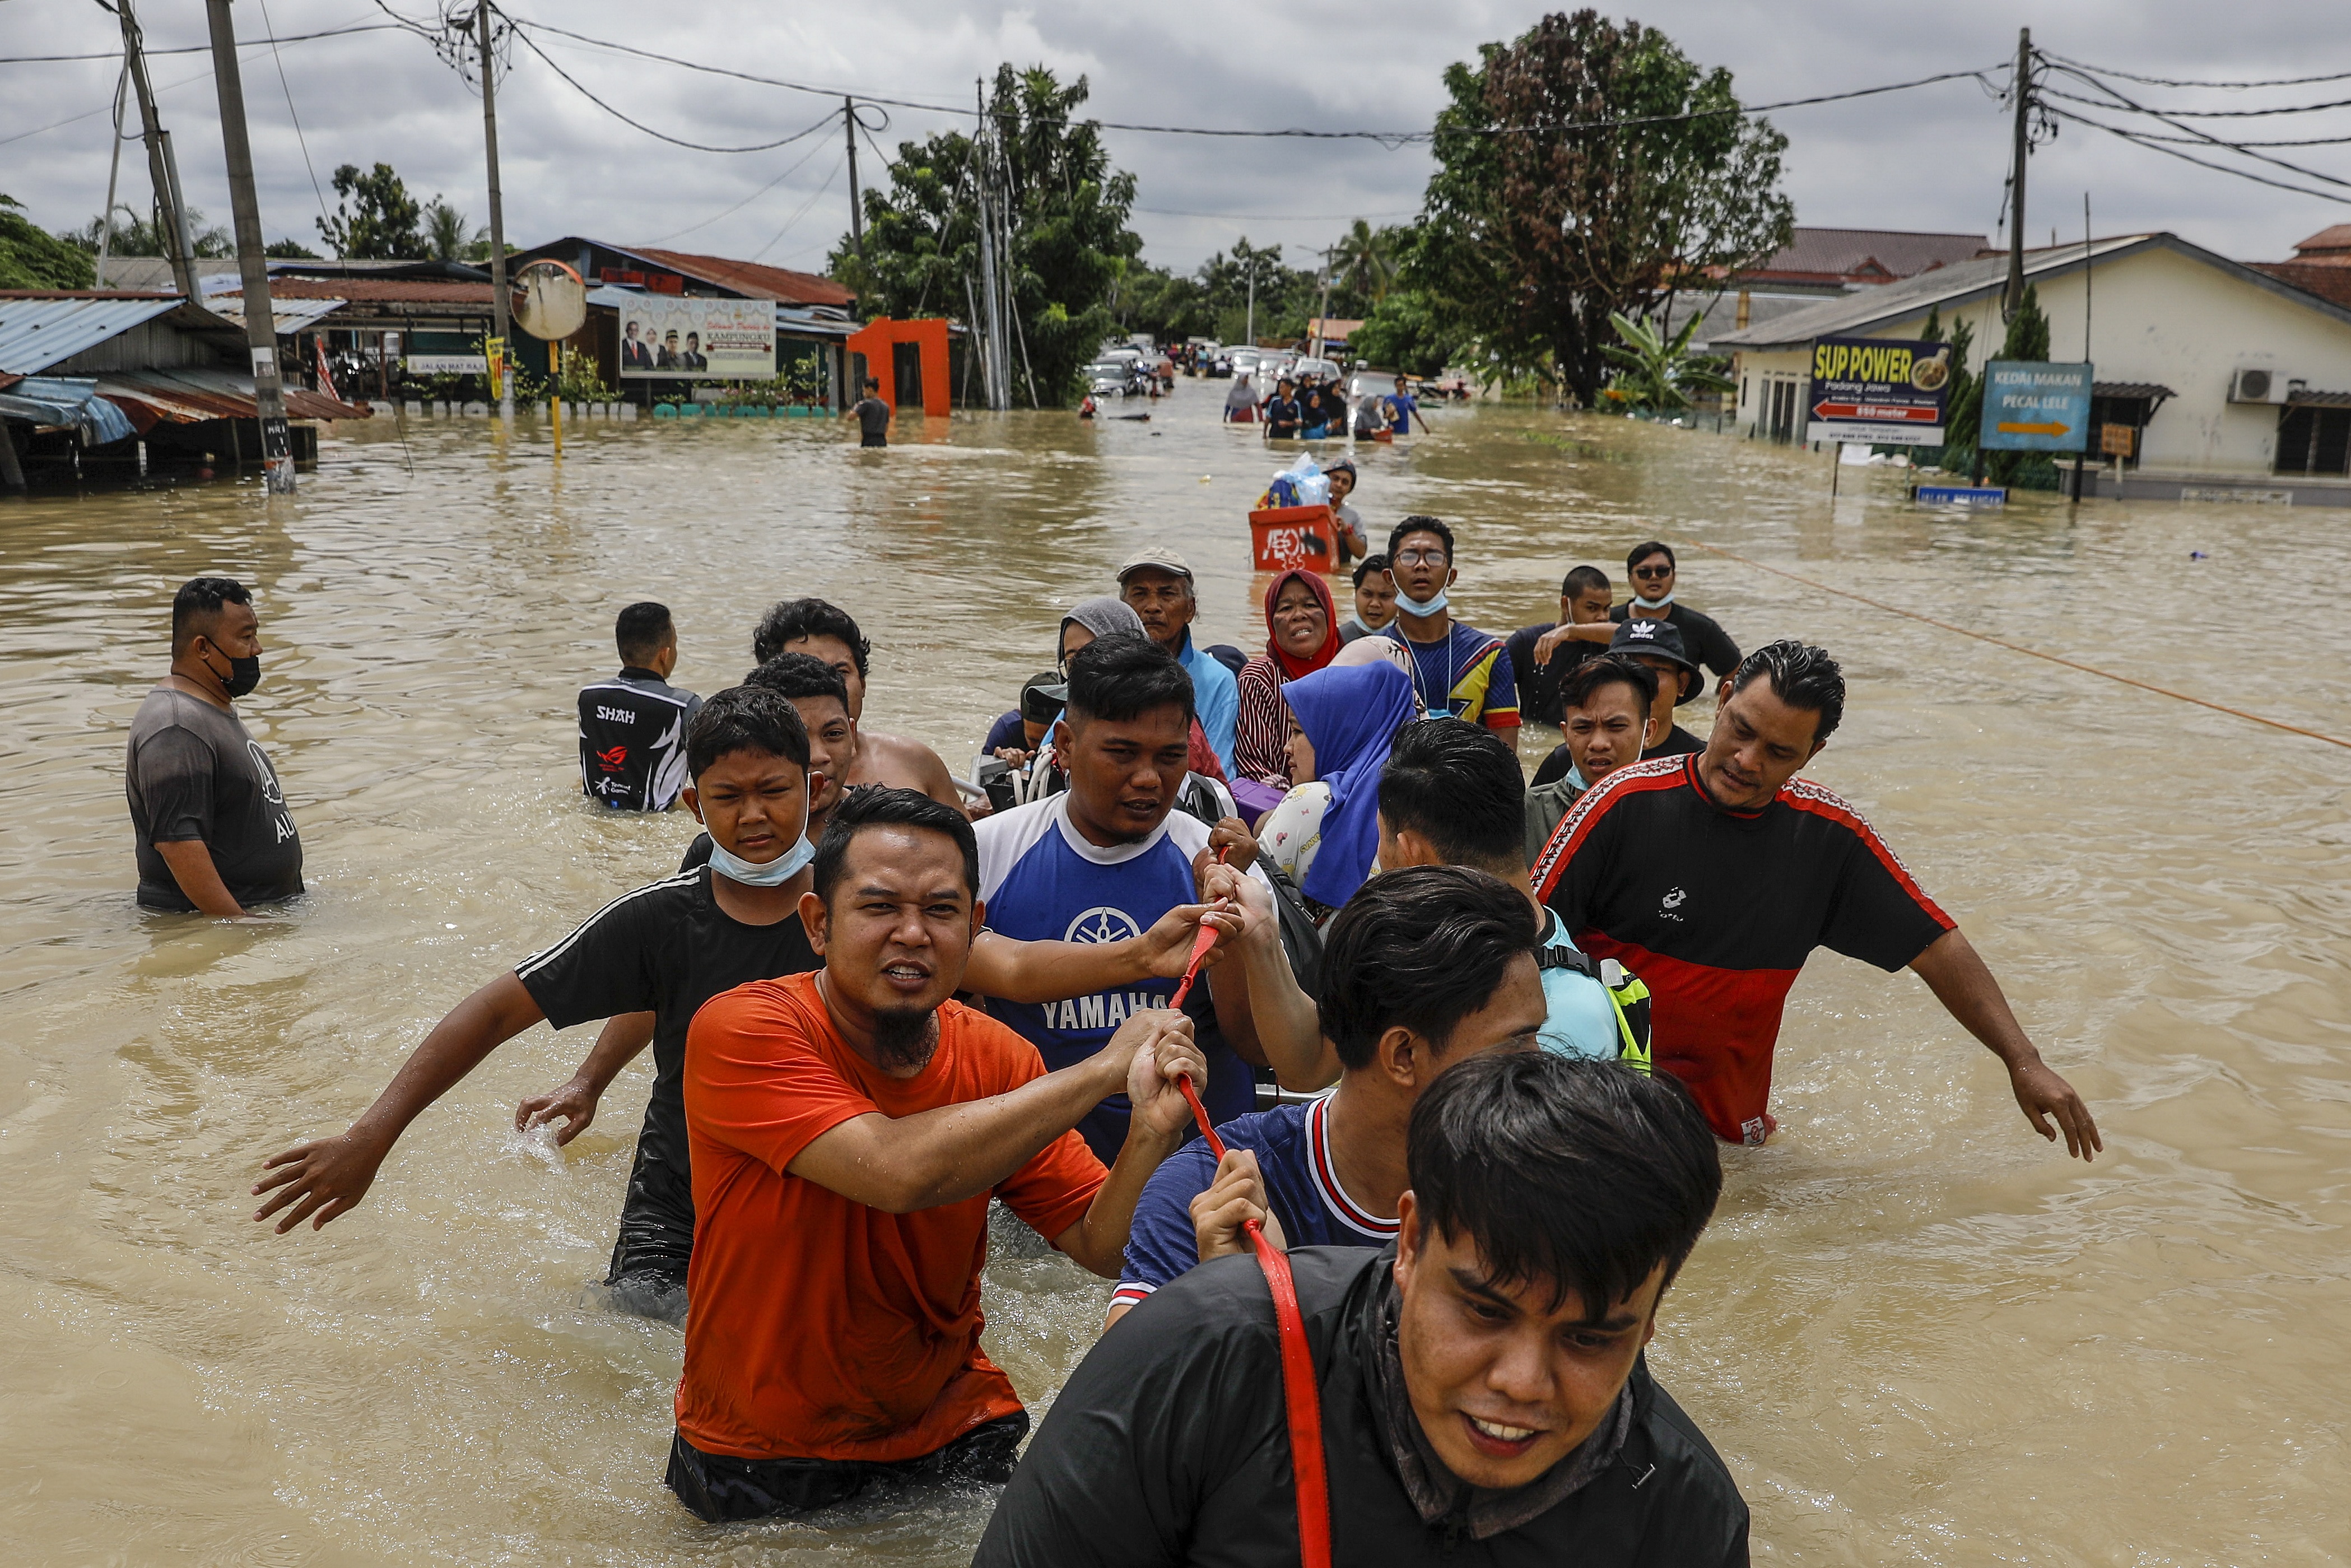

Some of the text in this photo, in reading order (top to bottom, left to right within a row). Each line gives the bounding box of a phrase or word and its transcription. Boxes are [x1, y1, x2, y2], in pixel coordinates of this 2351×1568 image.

[1814, 343, 1913, 384] SUP POWER
[1994, 371, 2083, 387] KEDAI MAKAN
[1824, 381, 1892, 394] Padang Jawa
[2002, 394, 2070, 410] PECAL LELE
[596, 705, 636, 724] SHAH
